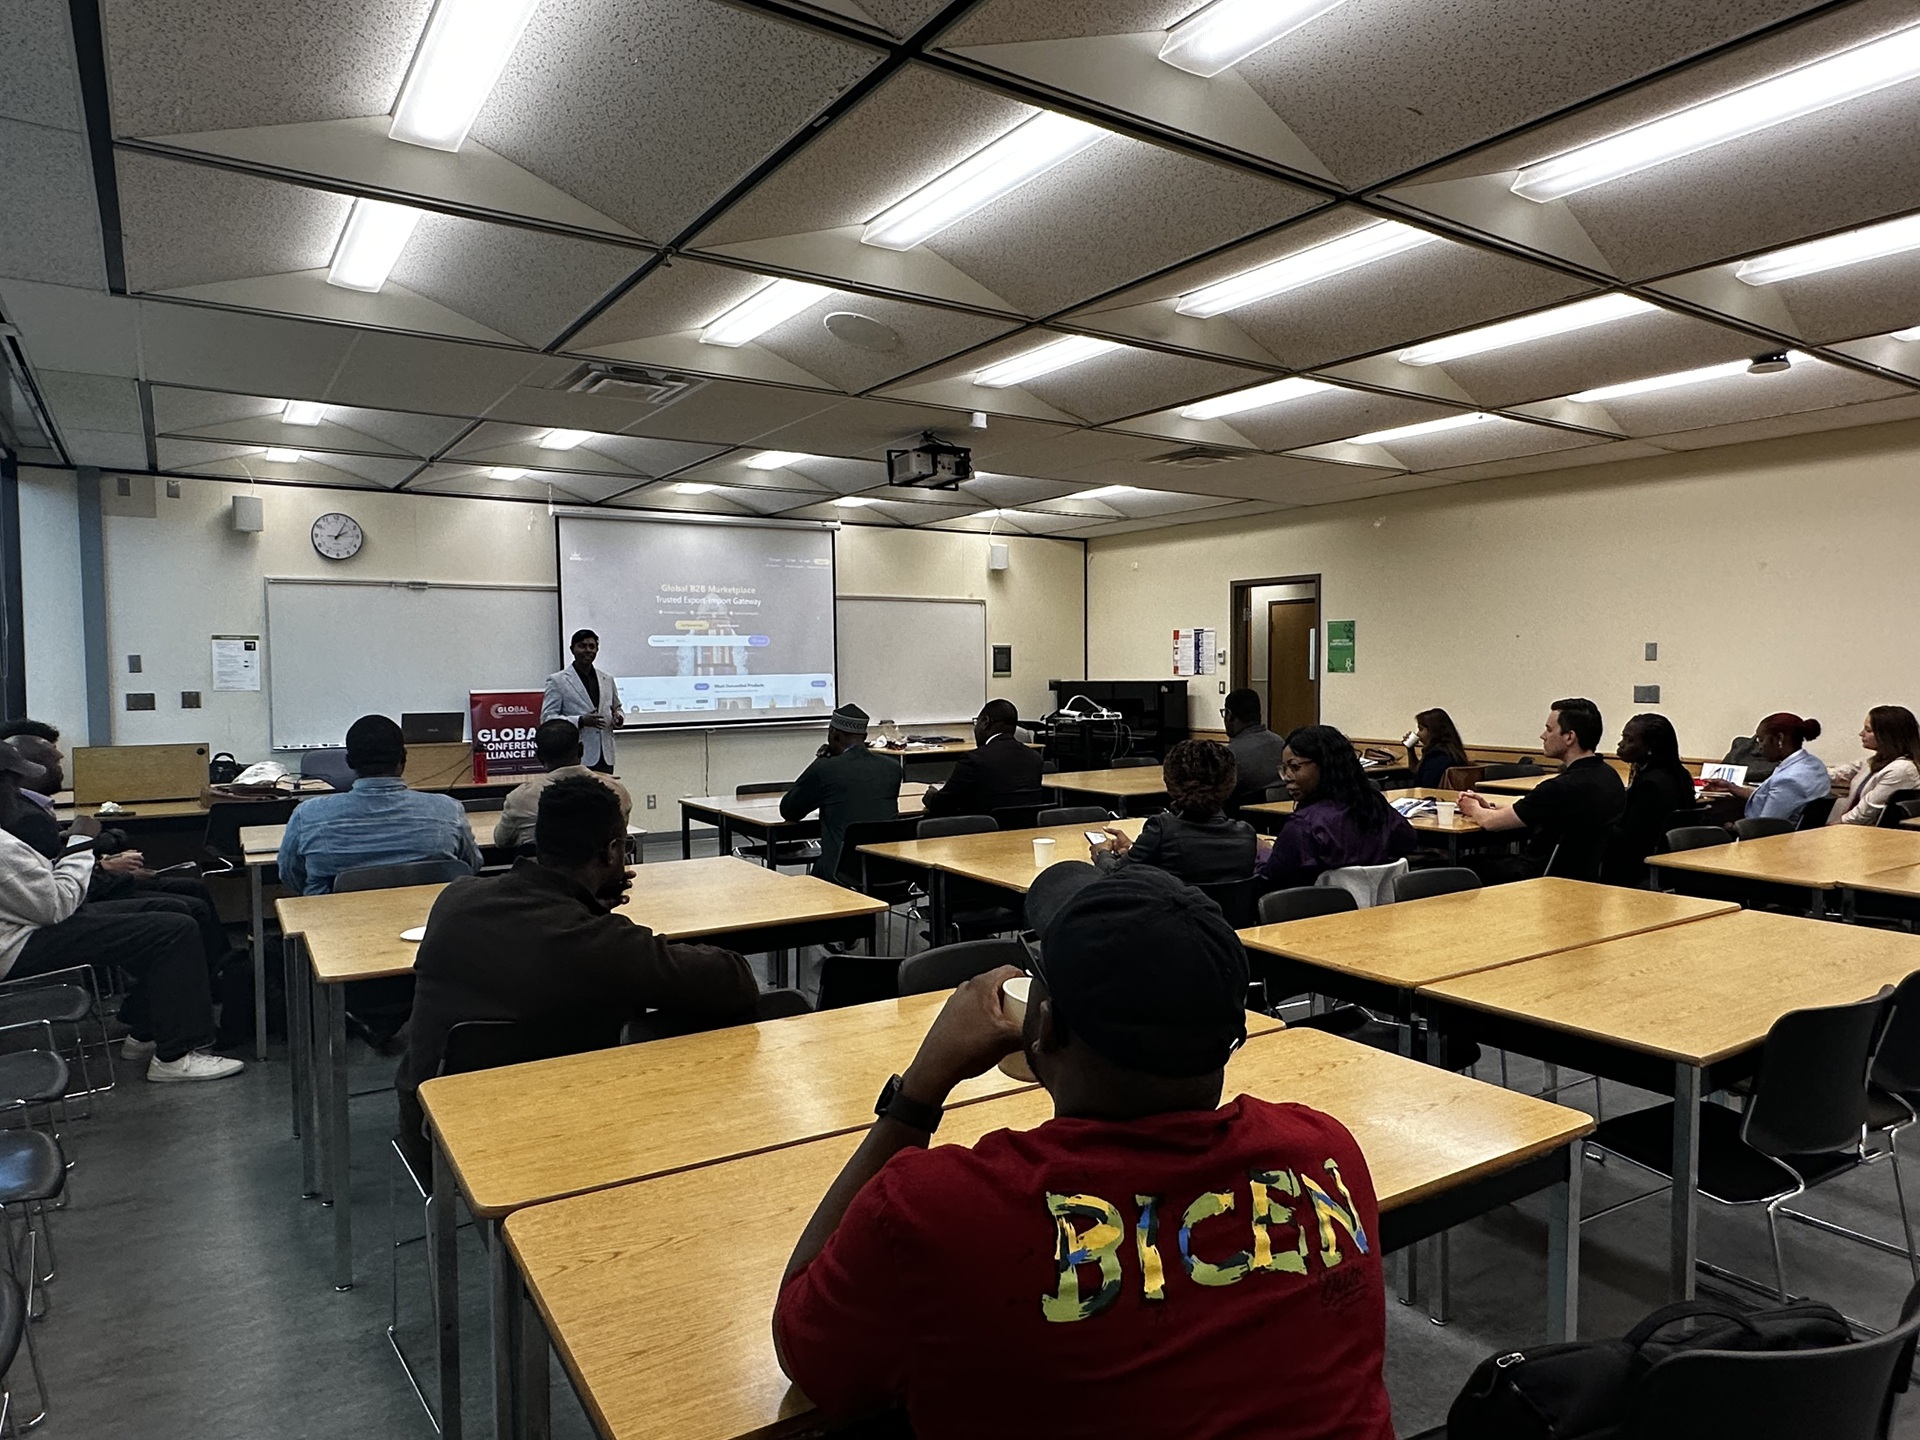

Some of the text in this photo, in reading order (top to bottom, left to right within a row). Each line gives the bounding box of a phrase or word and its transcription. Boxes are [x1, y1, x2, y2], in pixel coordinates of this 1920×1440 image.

[661, 584, 756, 595] Global B2B Marketplace
[656, 595, 762, 607] Trusted Export-Import Gateway
[477, 727, 537, 742] GLOBA
[483, 741, 538, 751] ONFEREN
[485, 750, 536, 760] LLIANCE IN
[1041, 1157, 1370, 1323] BICEN
